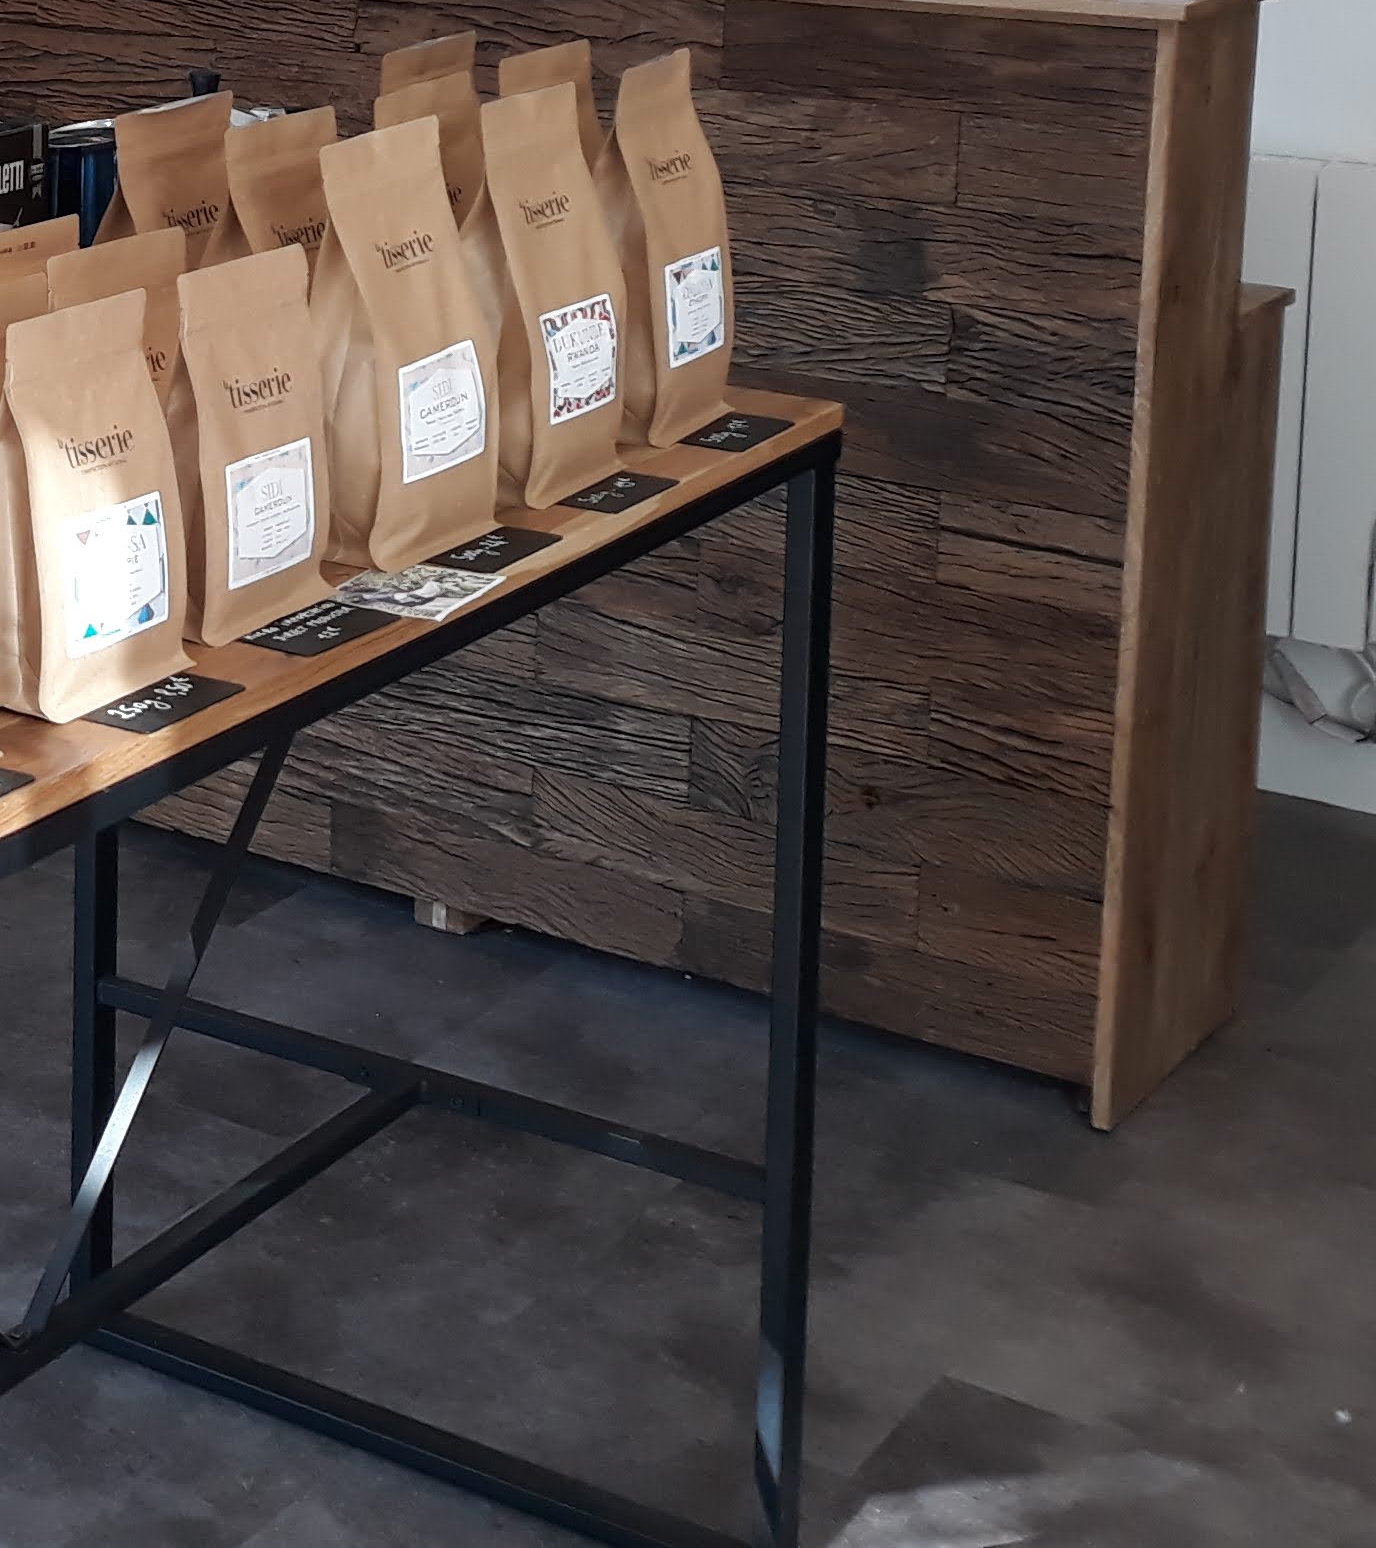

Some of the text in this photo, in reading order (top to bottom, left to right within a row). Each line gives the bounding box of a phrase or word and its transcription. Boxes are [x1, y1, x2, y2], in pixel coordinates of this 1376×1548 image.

[381, 230, 434, 269] tisserie
[229, 367, 293, 408] tisserie
[419, 392, 469, 420] CAMEROUN
[64, 424, 135, 469] tisserie
